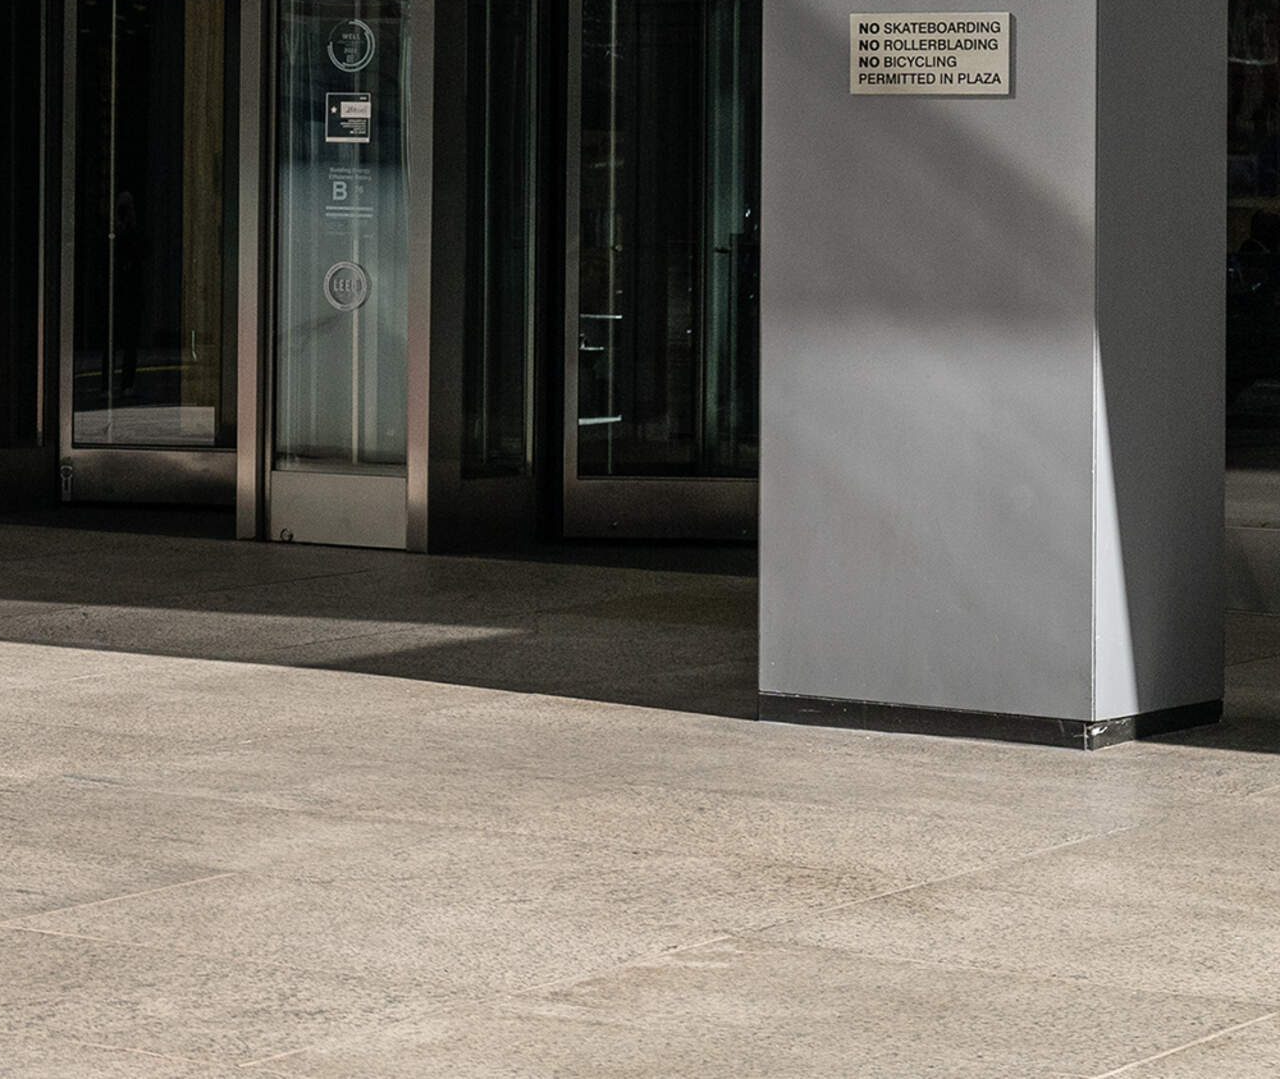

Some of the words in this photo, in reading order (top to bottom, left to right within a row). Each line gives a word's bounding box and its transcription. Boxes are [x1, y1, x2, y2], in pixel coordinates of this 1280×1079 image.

[859, 22, 880, 34] NO
[883, 21, 1001, 34] SKATEBOARDING
[859, 39, 880, 51] NO
[883, 38, 998, 51] ROLLERBLADING
[859, 56, 880, 68] NO
[883, 55, 957, 68] BICYCLING
[859, 73, 936, 85] PERMITTED
[940, 73, 953, 84] IN
[957, 72, 1001, 84] PLAZA
[332, 181, 348, 200] B
